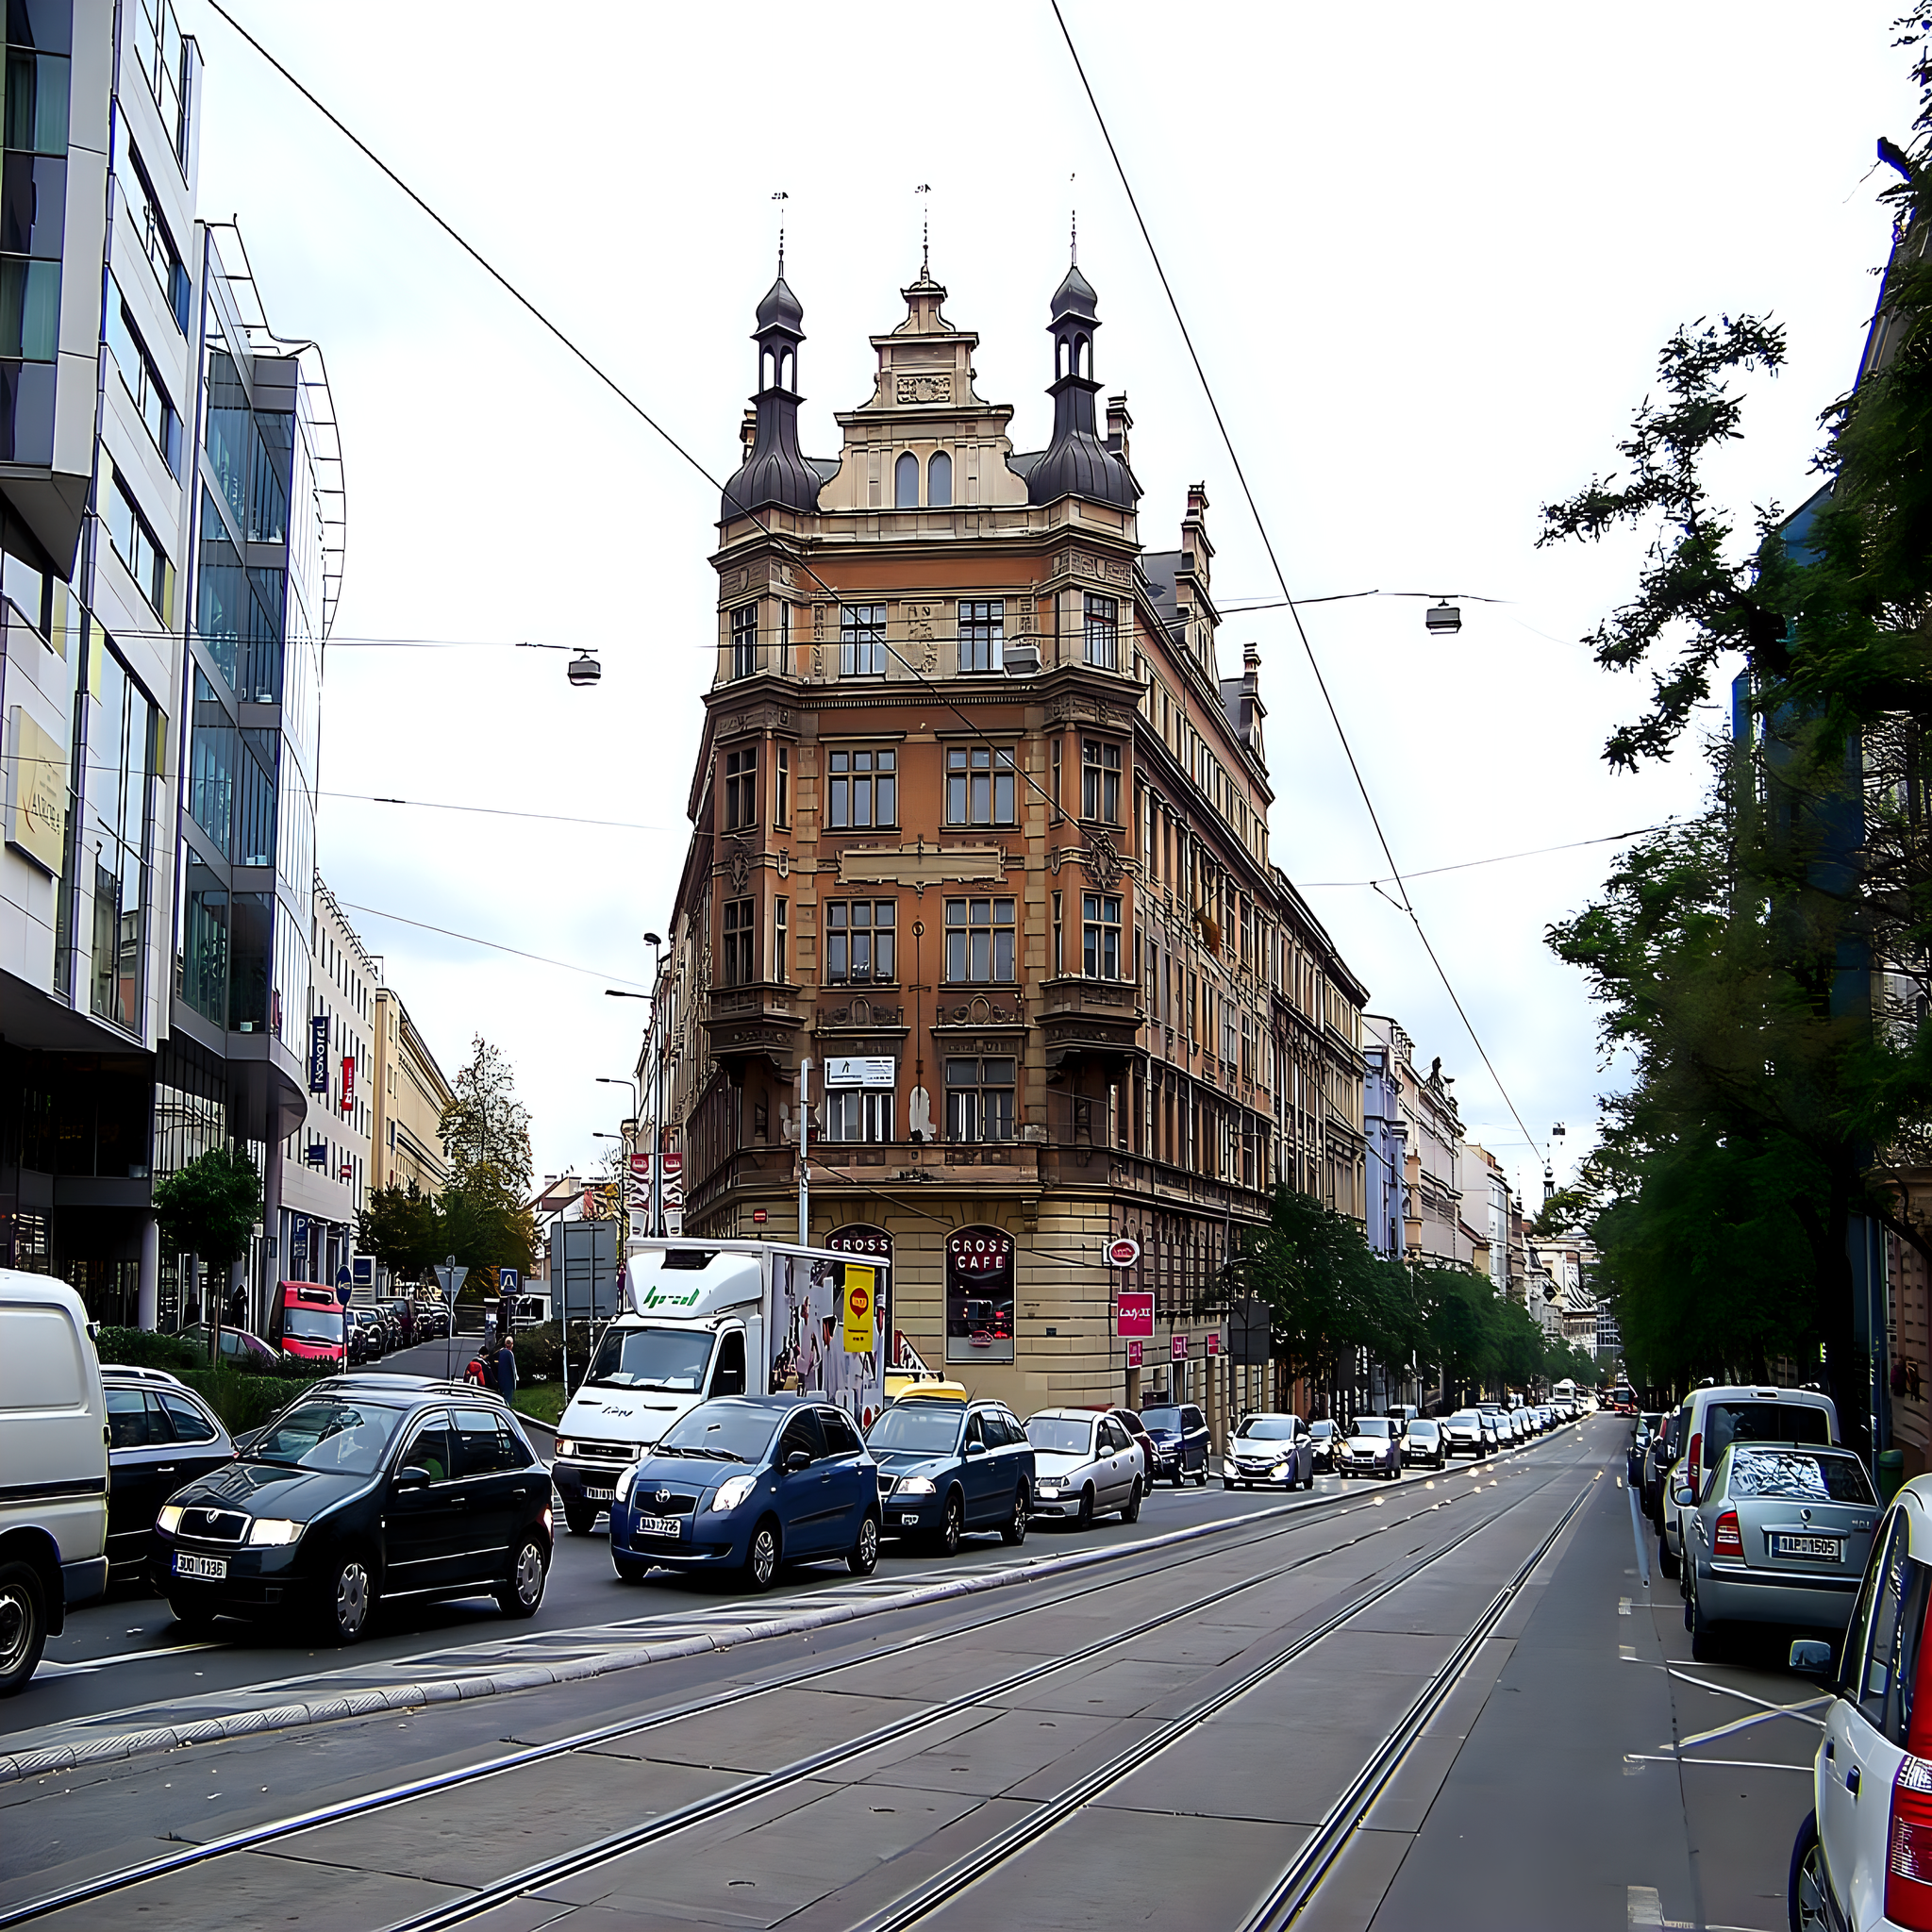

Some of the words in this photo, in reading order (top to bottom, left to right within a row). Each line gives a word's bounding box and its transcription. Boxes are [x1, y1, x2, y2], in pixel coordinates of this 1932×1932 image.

[314, 1020, 325, 1084] NOVOTEL
[296, 1218, 306, 1233] P
[831, 1239, 889, 1251] CROSS
[951, 1239, 1009, 1253] CROSS
